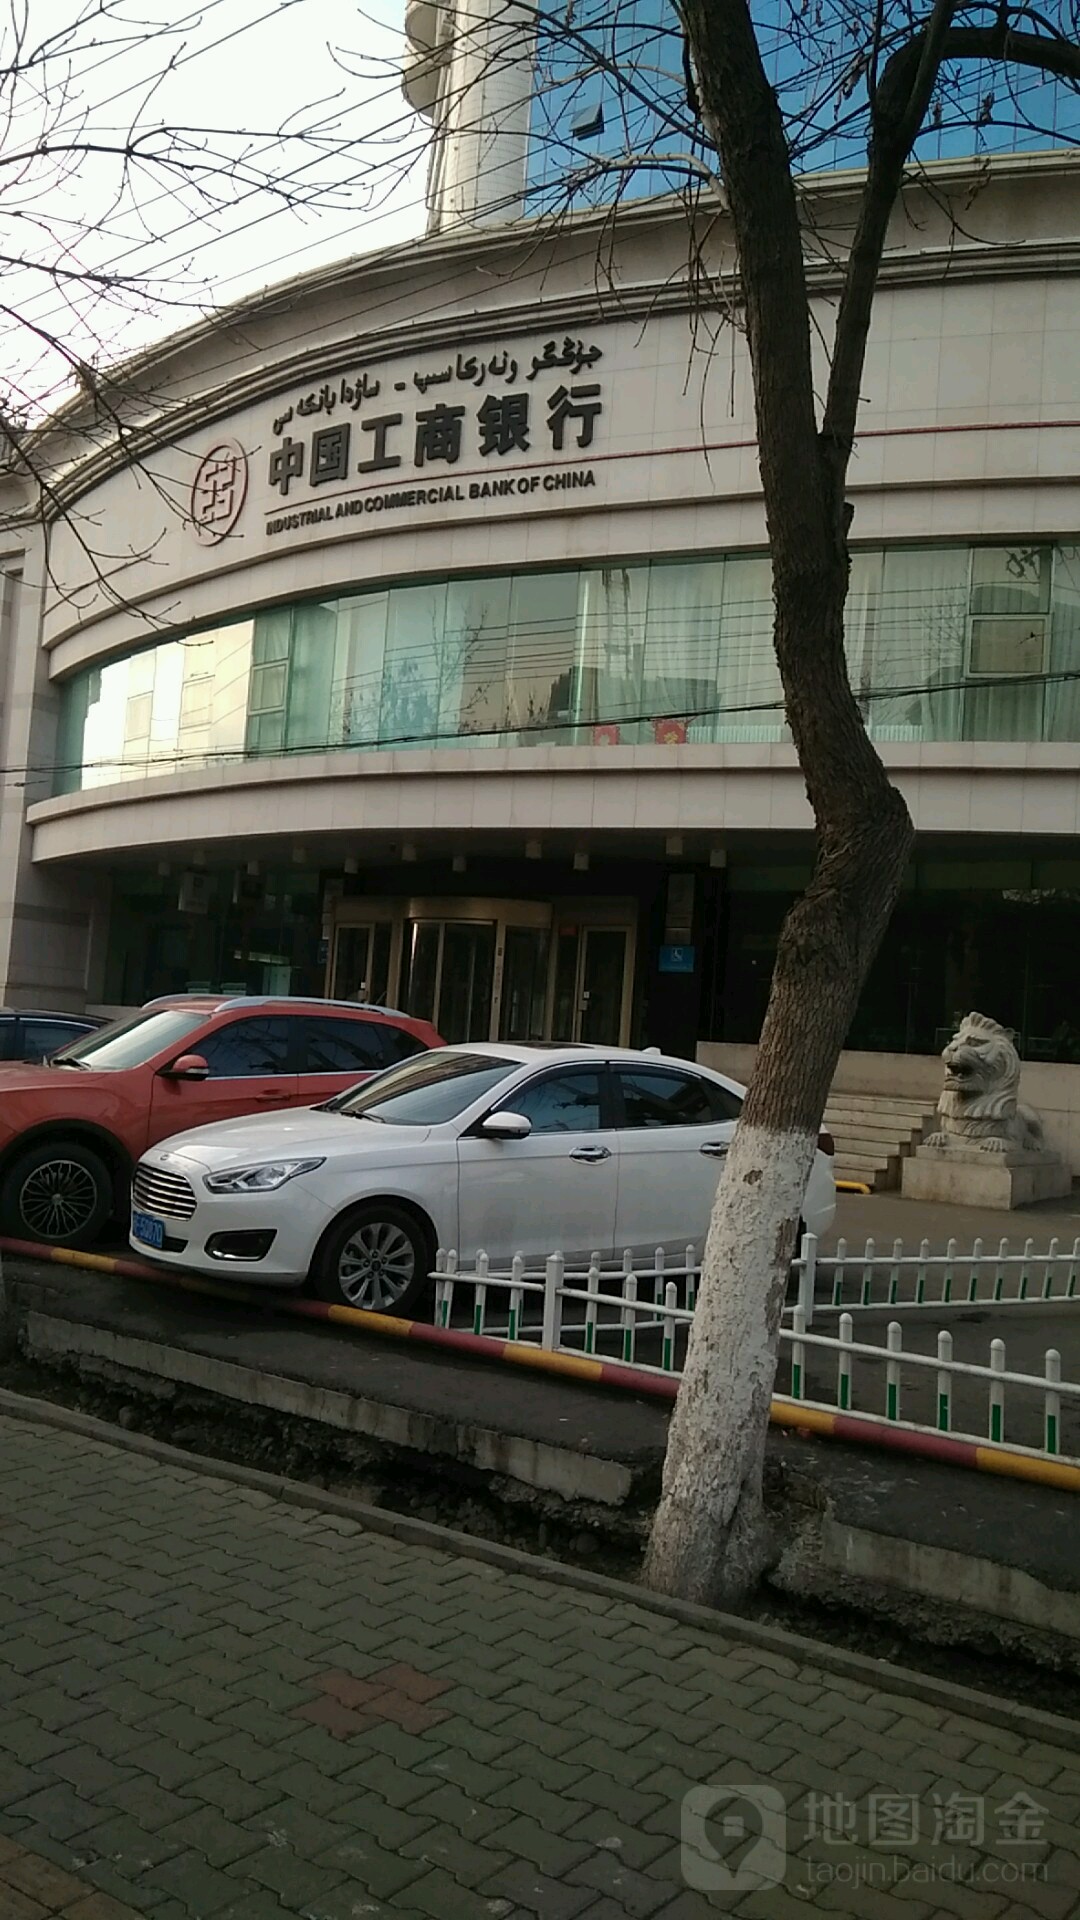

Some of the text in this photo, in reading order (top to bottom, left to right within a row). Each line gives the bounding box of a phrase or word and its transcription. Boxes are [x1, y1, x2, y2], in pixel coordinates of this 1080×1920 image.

[268, 383, 603, 496] 中国工商银行
[266, 470, 596, 535] INDUSTRIAL AND COMMERCIAL BANK OF CHINA
